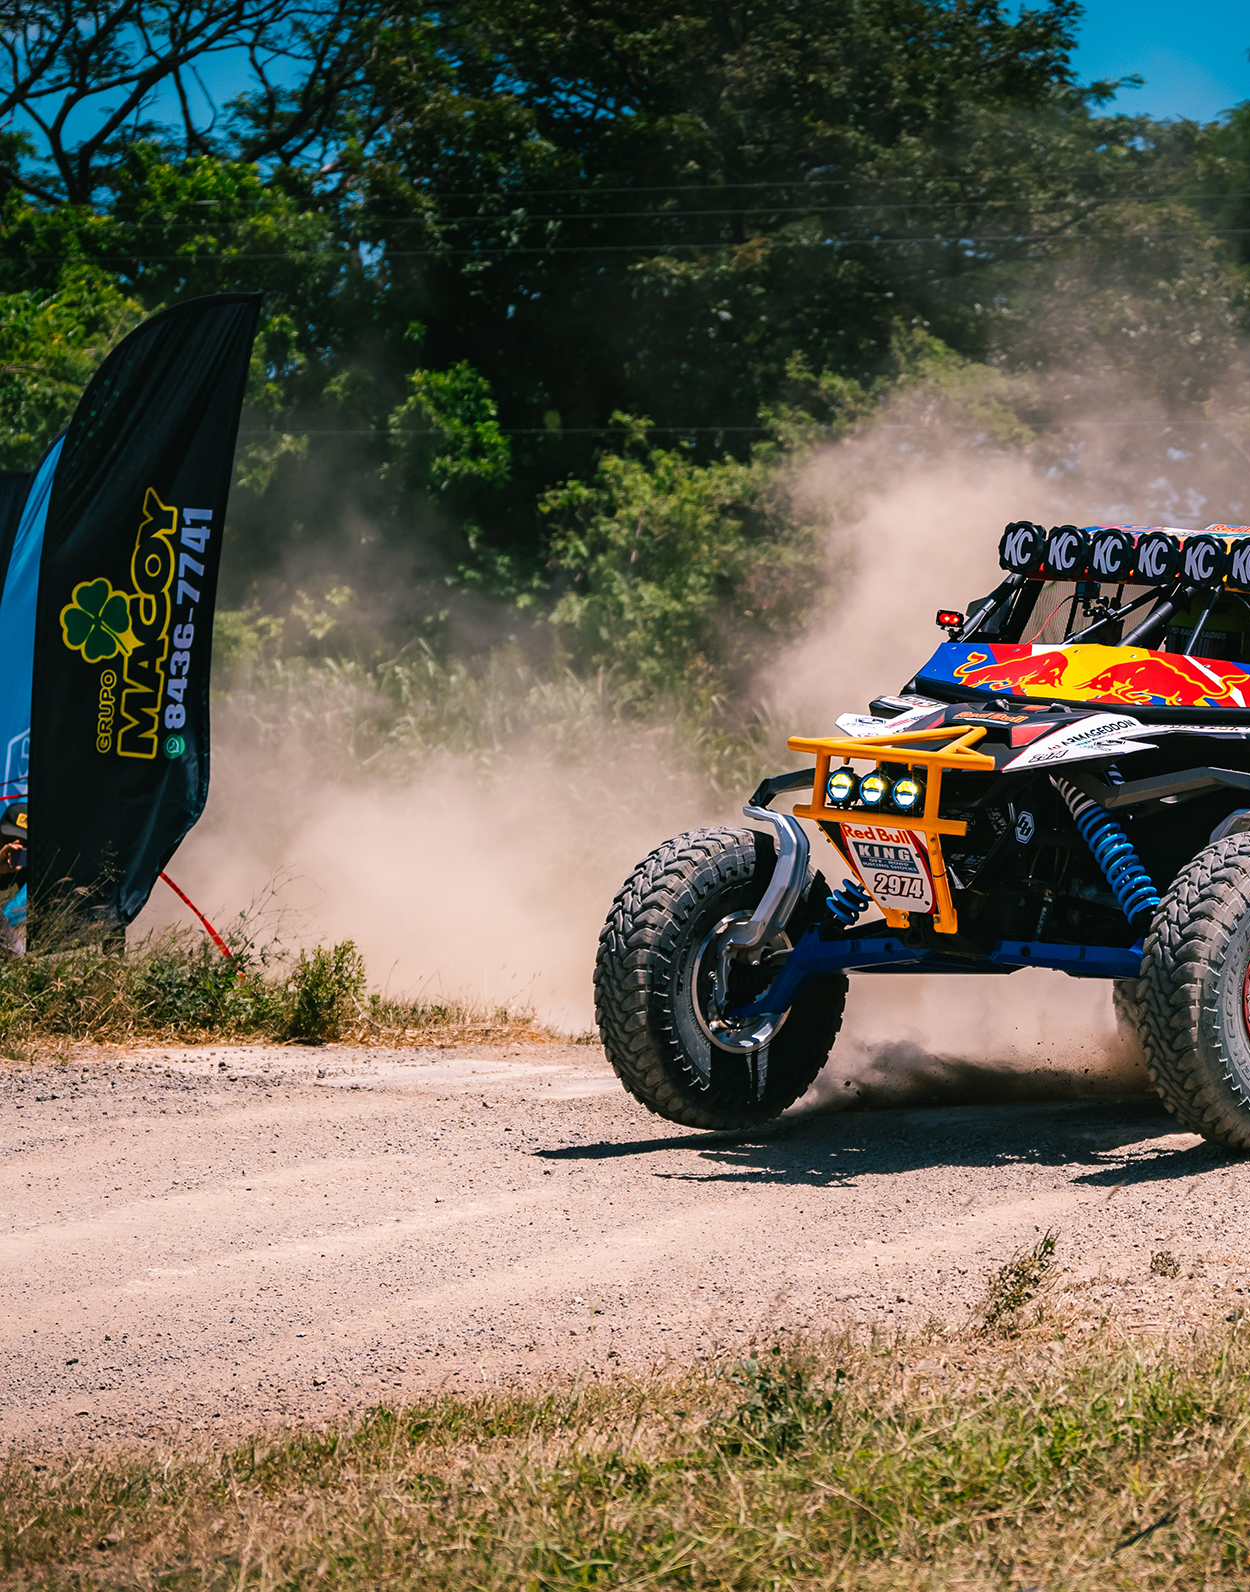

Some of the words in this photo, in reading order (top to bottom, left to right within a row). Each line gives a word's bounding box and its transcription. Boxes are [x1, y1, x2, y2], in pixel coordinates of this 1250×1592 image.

[1004, 528, 1034, 566] KC
[1211, 524, 1244, 533] Red
[1048, 532, 1078, 571] KC
[1093, 536, 1123, 574] KC
[1138, 539, 1168, 578] KC
[1184, 541, 1216, 581] KC
[117, 486, 178, 759] MACOY
[164, 508, 213, 730] 8436-7741
[96, 669, 117, 754] GRUPO
[1061, 719, 1137, 747] ARMAGEDDON
[840, 823, 877, 841] Red
[875, 827, 911, 845] Bull
[858, 844, 911, 862] KING
[863, 861, 890, 869] RACING
[873, 872, 924, 899] 2974
